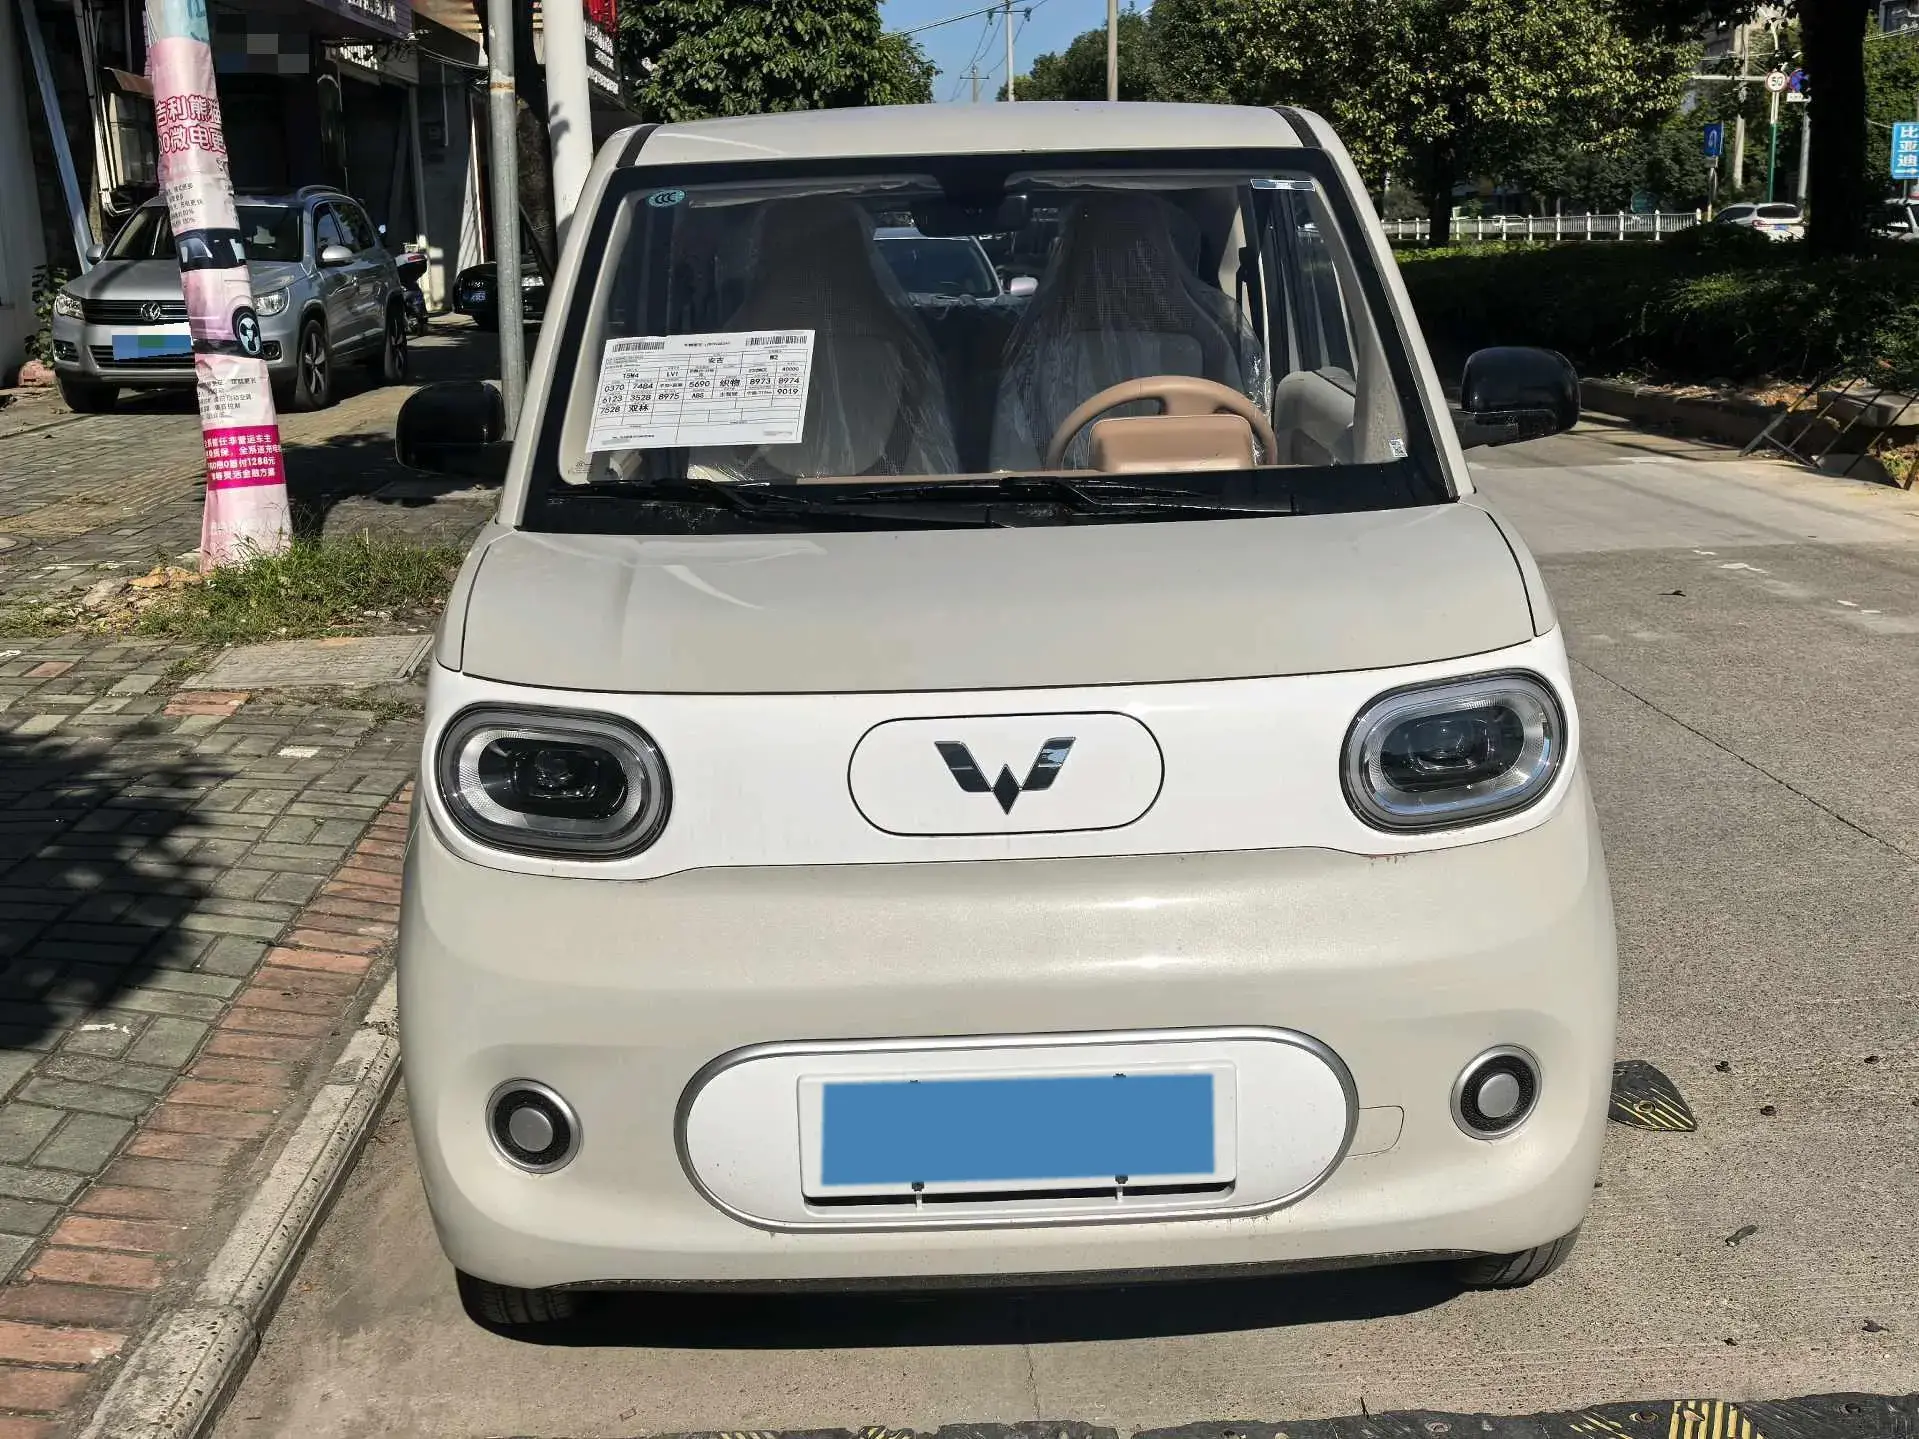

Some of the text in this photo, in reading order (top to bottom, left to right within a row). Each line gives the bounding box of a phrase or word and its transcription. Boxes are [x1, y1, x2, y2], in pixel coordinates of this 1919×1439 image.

[1898, 126, 1918, 166] 比亚迪
[604, 384, 625, 392] 0370
[689, 380, 710, 388] 5690
[602, 396, 623, 404] 6123
